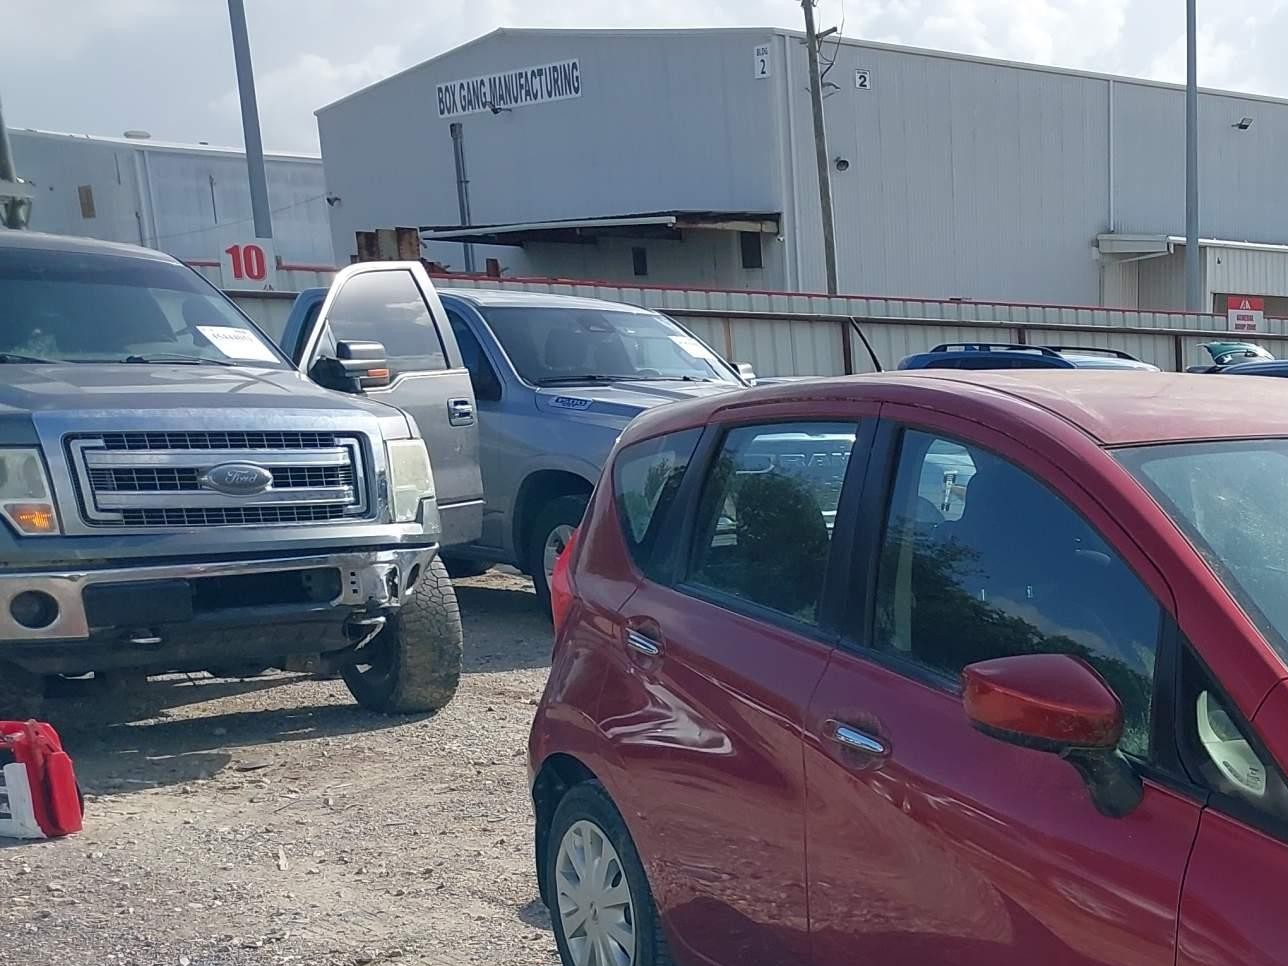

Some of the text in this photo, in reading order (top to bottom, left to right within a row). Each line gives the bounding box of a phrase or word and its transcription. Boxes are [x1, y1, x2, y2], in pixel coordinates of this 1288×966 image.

[759, 58, 767, 75] 2
[437, 61, 580, 116] BOX GANG MANUFACTURING
[858, 74, 868, 88] 2
[224, 243, 267, 281] 10
[225, 469, 258, 485] Ford
